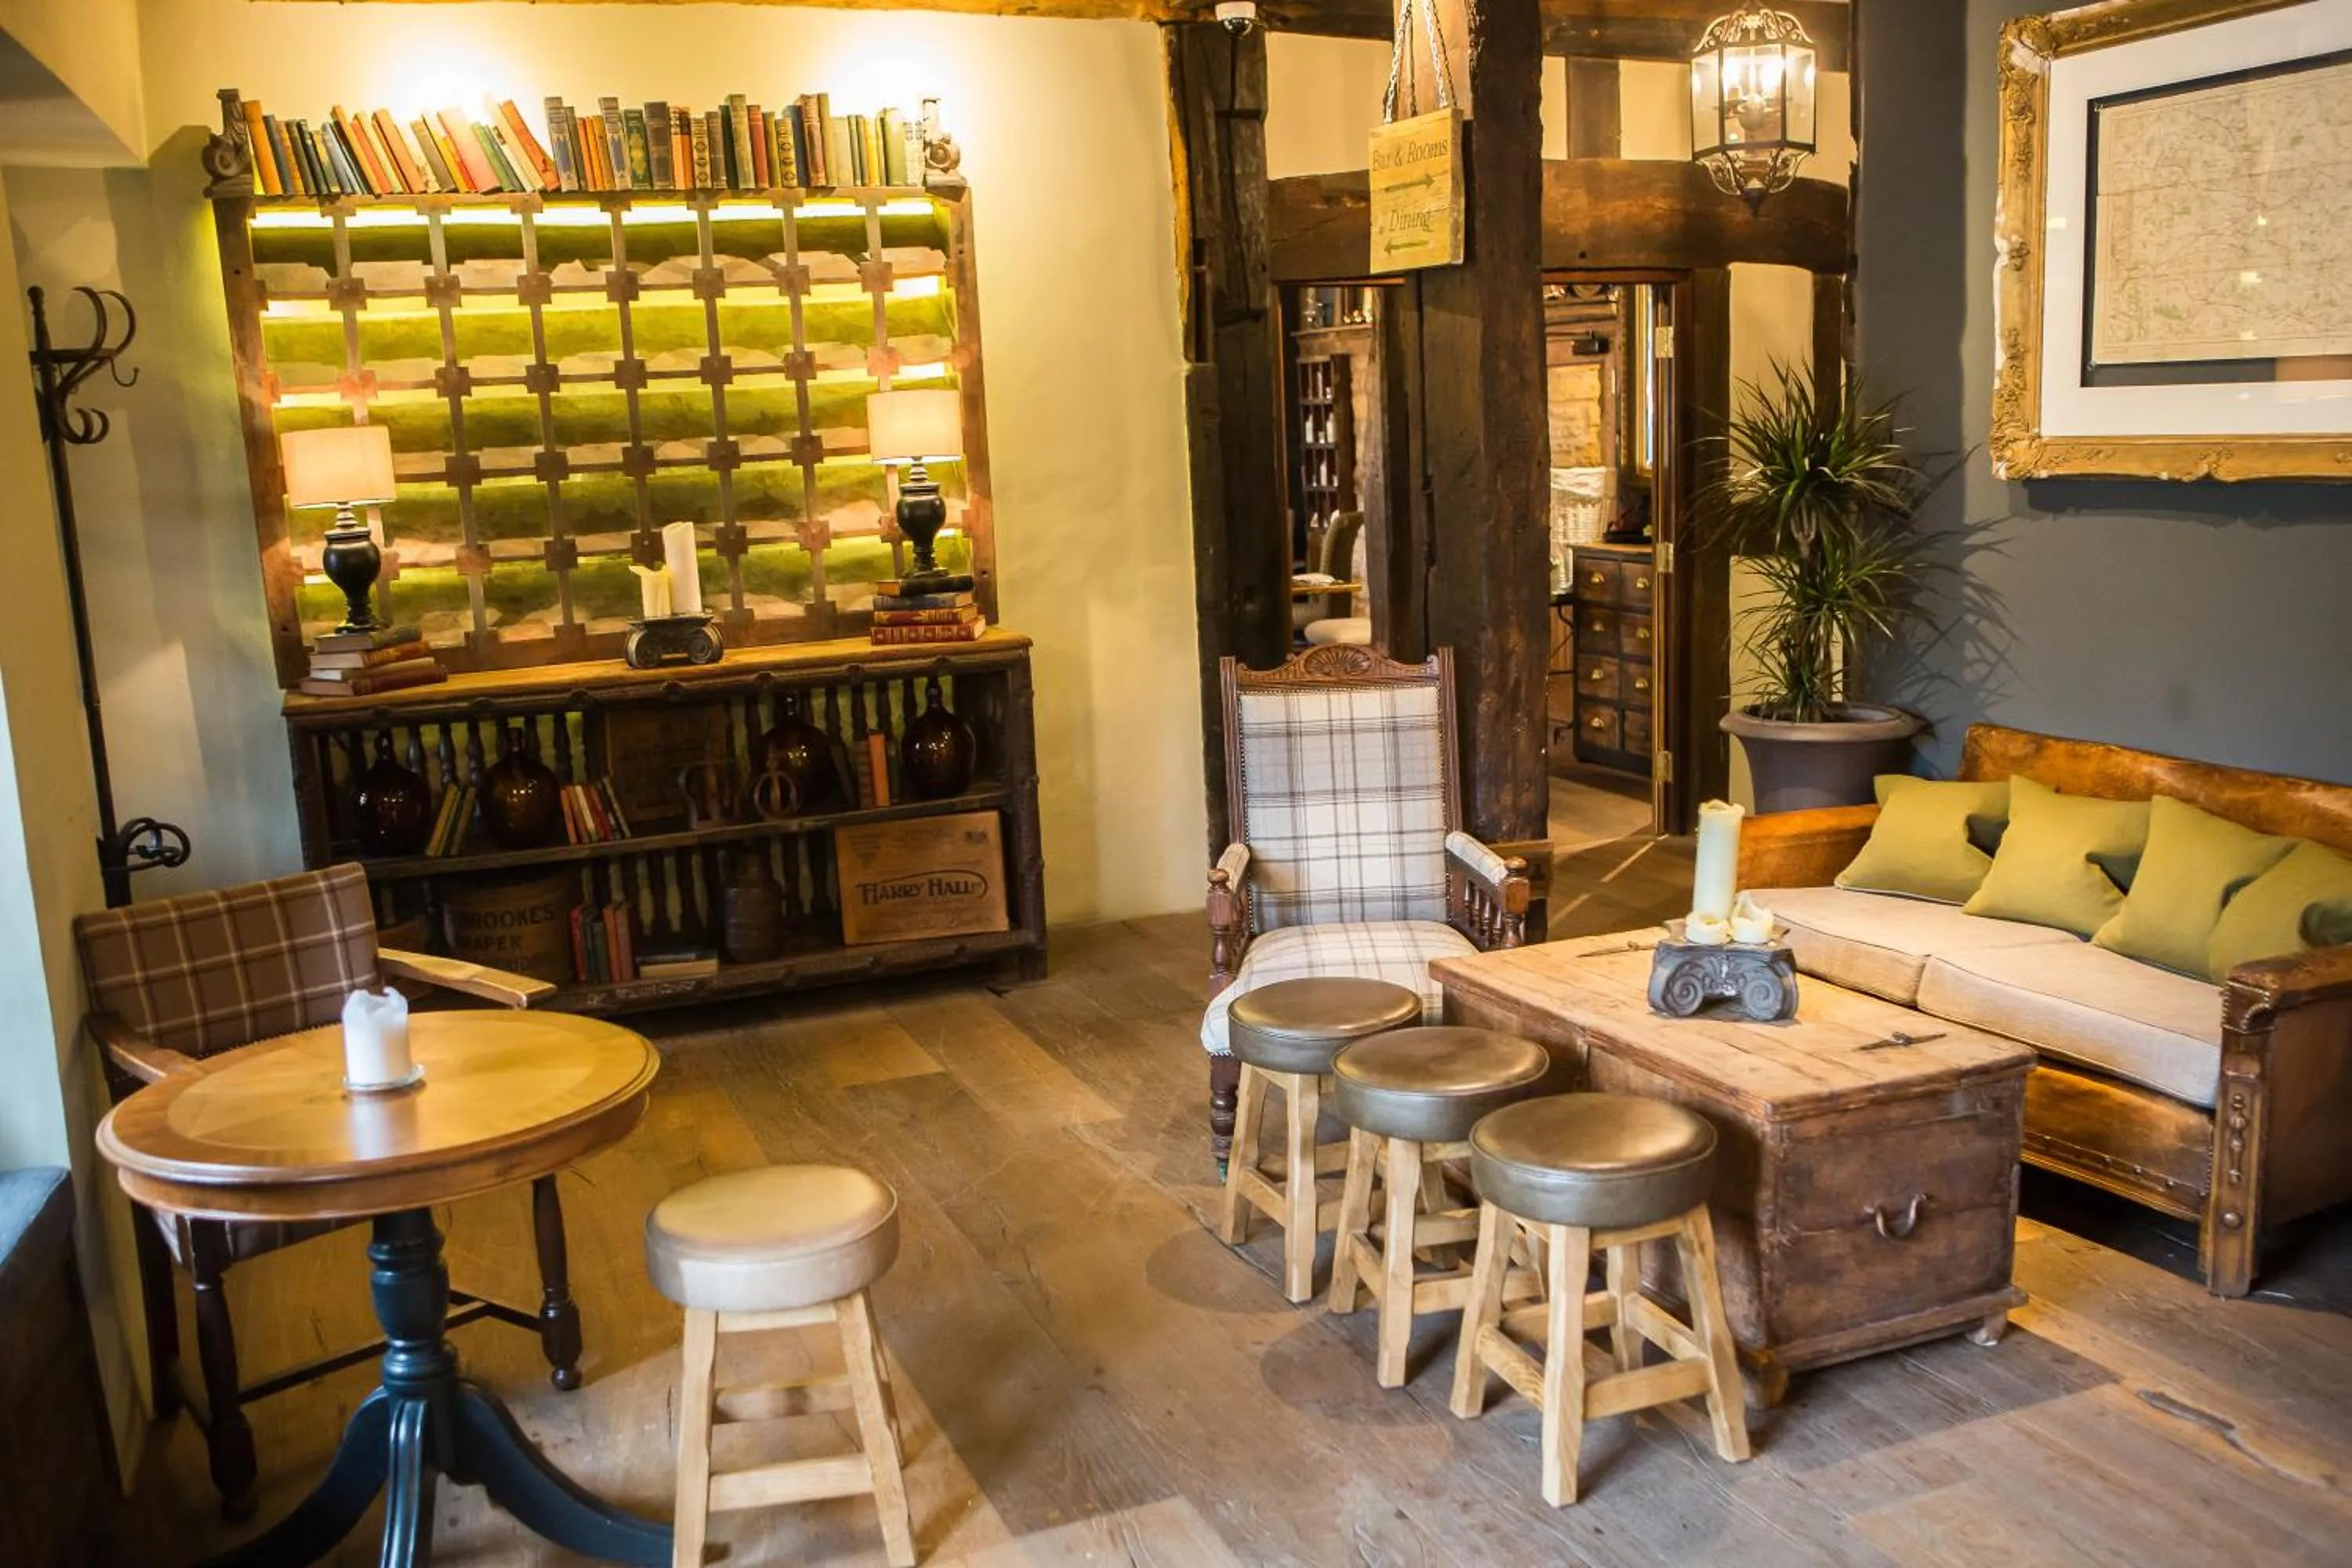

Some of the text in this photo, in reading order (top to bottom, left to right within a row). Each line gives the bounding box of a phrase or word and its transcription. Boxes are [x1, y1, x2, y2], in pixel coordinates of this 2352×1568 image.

[1373, 149, 1392, 172] Bar
[1407, 138, 1450, 162] Rooms
[1389, 207, 1436, 233] Dining
[855, 881, 924, 906] HARRY
[927, 877, 974, 897] HALL
